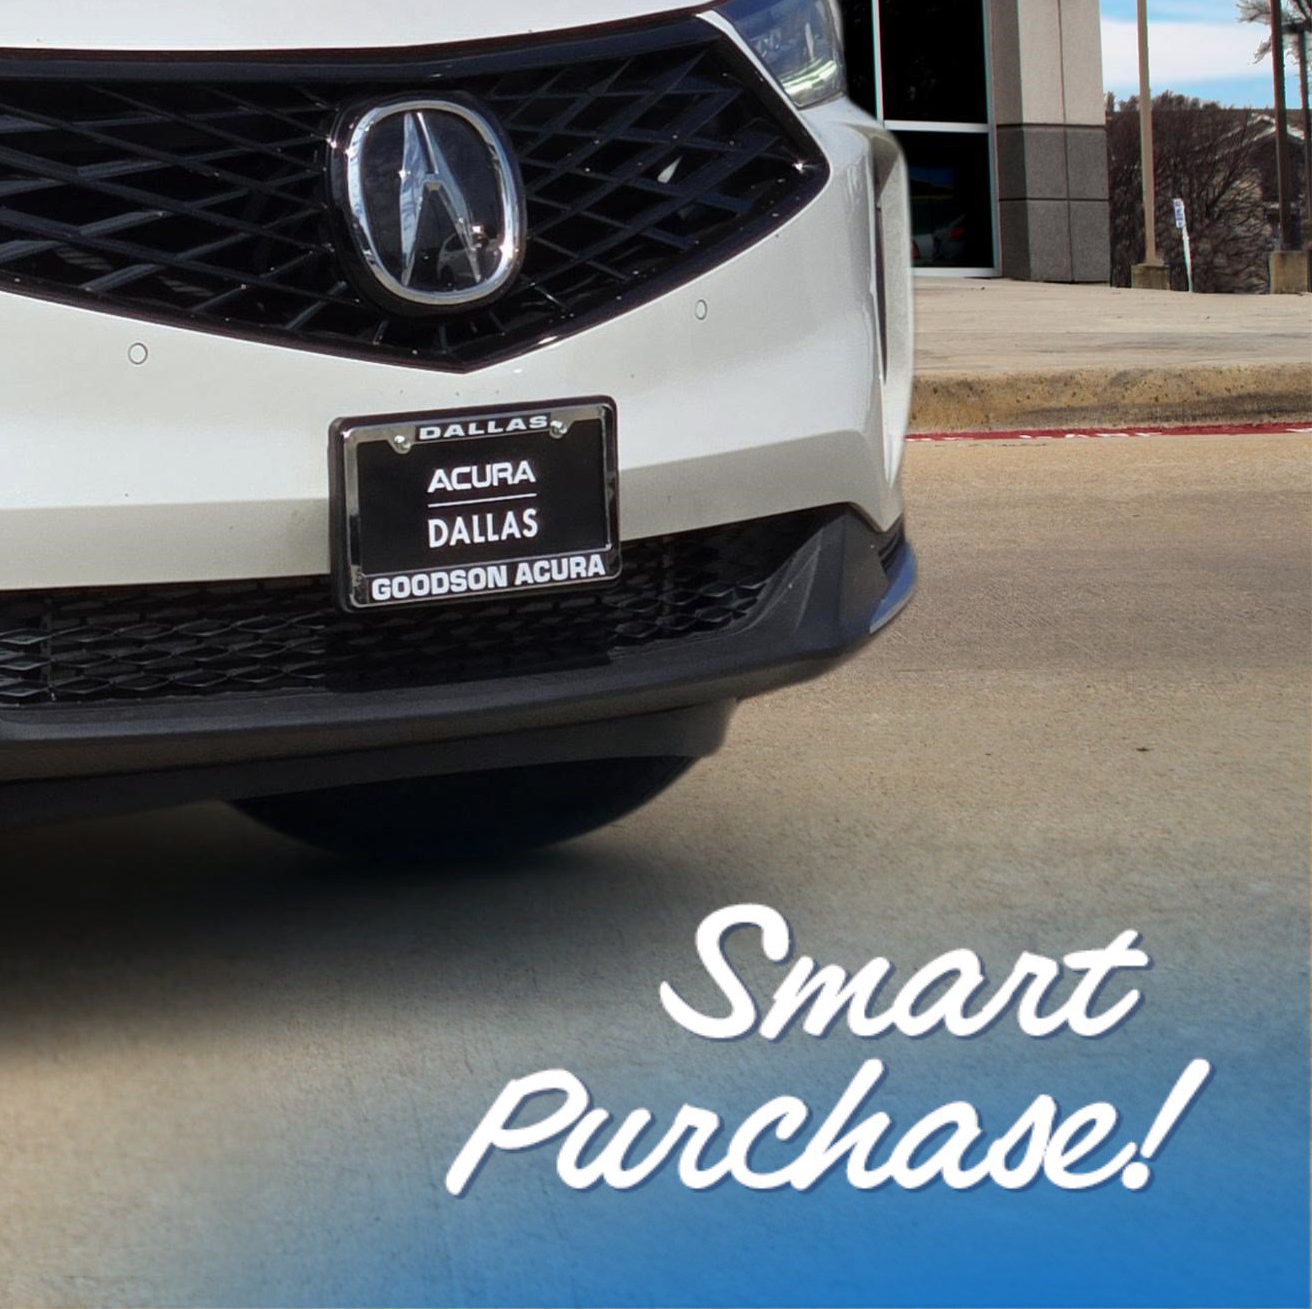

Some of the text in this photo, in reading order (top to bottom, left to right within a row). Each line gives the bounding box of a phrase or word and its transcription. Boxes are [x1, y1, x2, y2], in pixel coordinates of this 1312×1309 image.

[418, 414, 549, 441] DALLAS
[426, 459, 537, 493] ACURA
[427, 507, 539, 549] DALLAS
[370, 553, 607, 602] GOODSON ACURA
